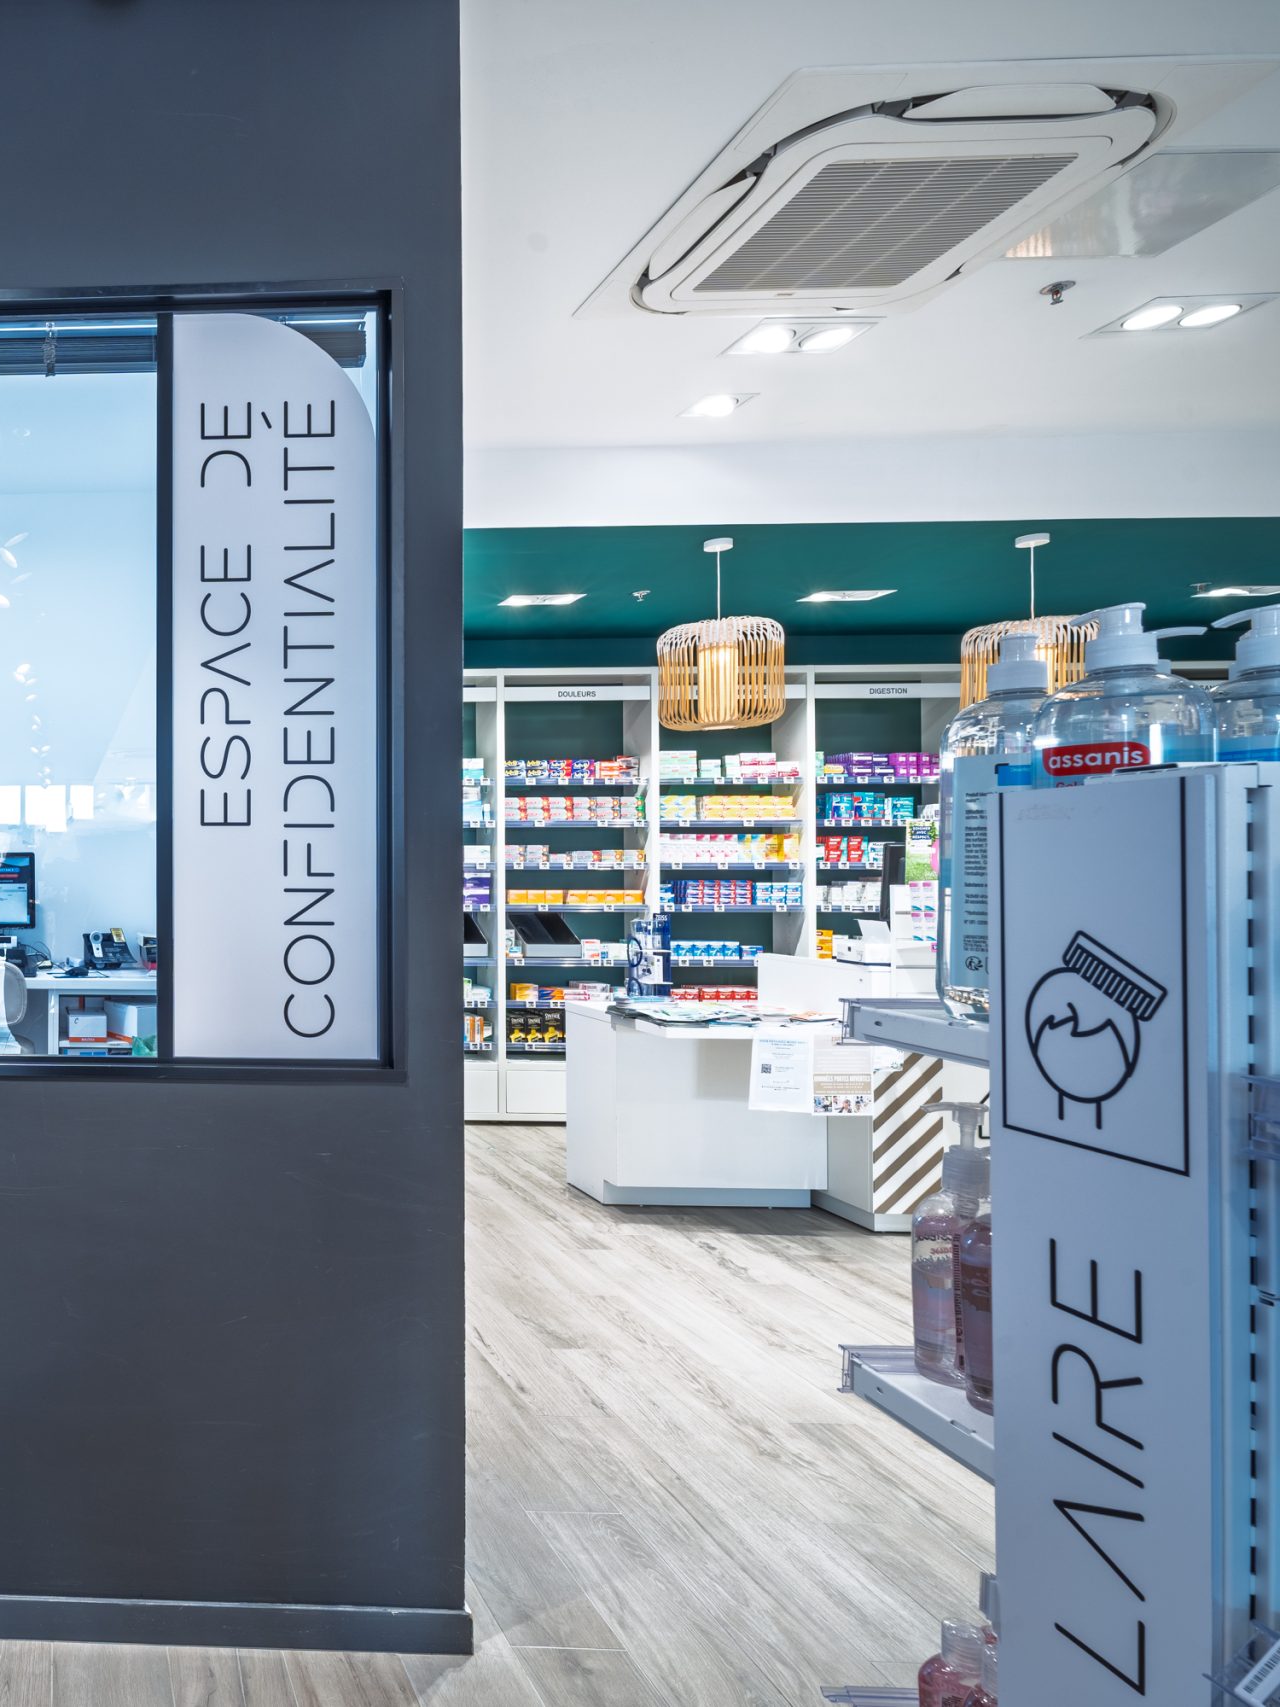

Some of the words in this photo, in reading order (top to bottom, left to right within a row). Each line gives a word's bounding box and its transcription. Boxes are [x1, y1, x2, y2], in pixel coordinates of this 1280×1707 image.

[200, 401, 252, 487] DE
[200, 543, 252, 826] ESPACE
[261, 400, 336, 1038] CONFIDENTIALITÉ
[869, 687, 908, 695] DIGESTION
[1048, 747, 1143, 769] assanis
